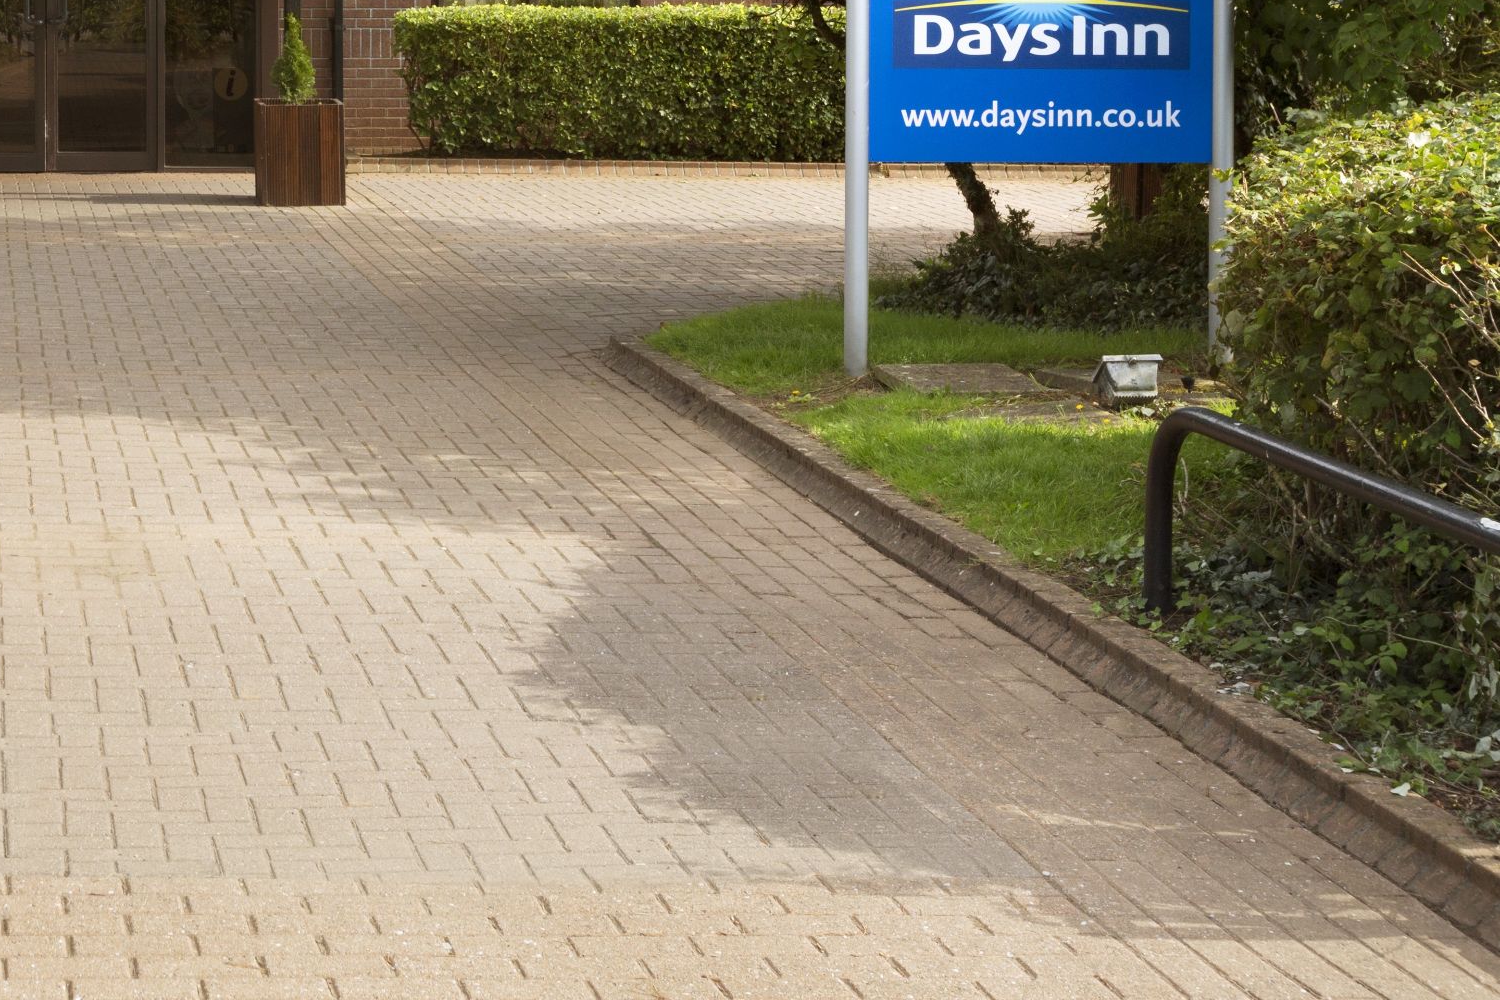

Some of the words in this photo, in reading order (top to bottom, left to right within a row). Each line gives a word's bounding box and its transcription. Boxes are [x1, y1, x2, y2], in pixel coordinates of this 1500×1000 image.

[913, 14, 1061, 62] Days
[1072, 15, 1170, 56] Inn
[901, 100, 1181, 136] www.daysinn.co.uk
